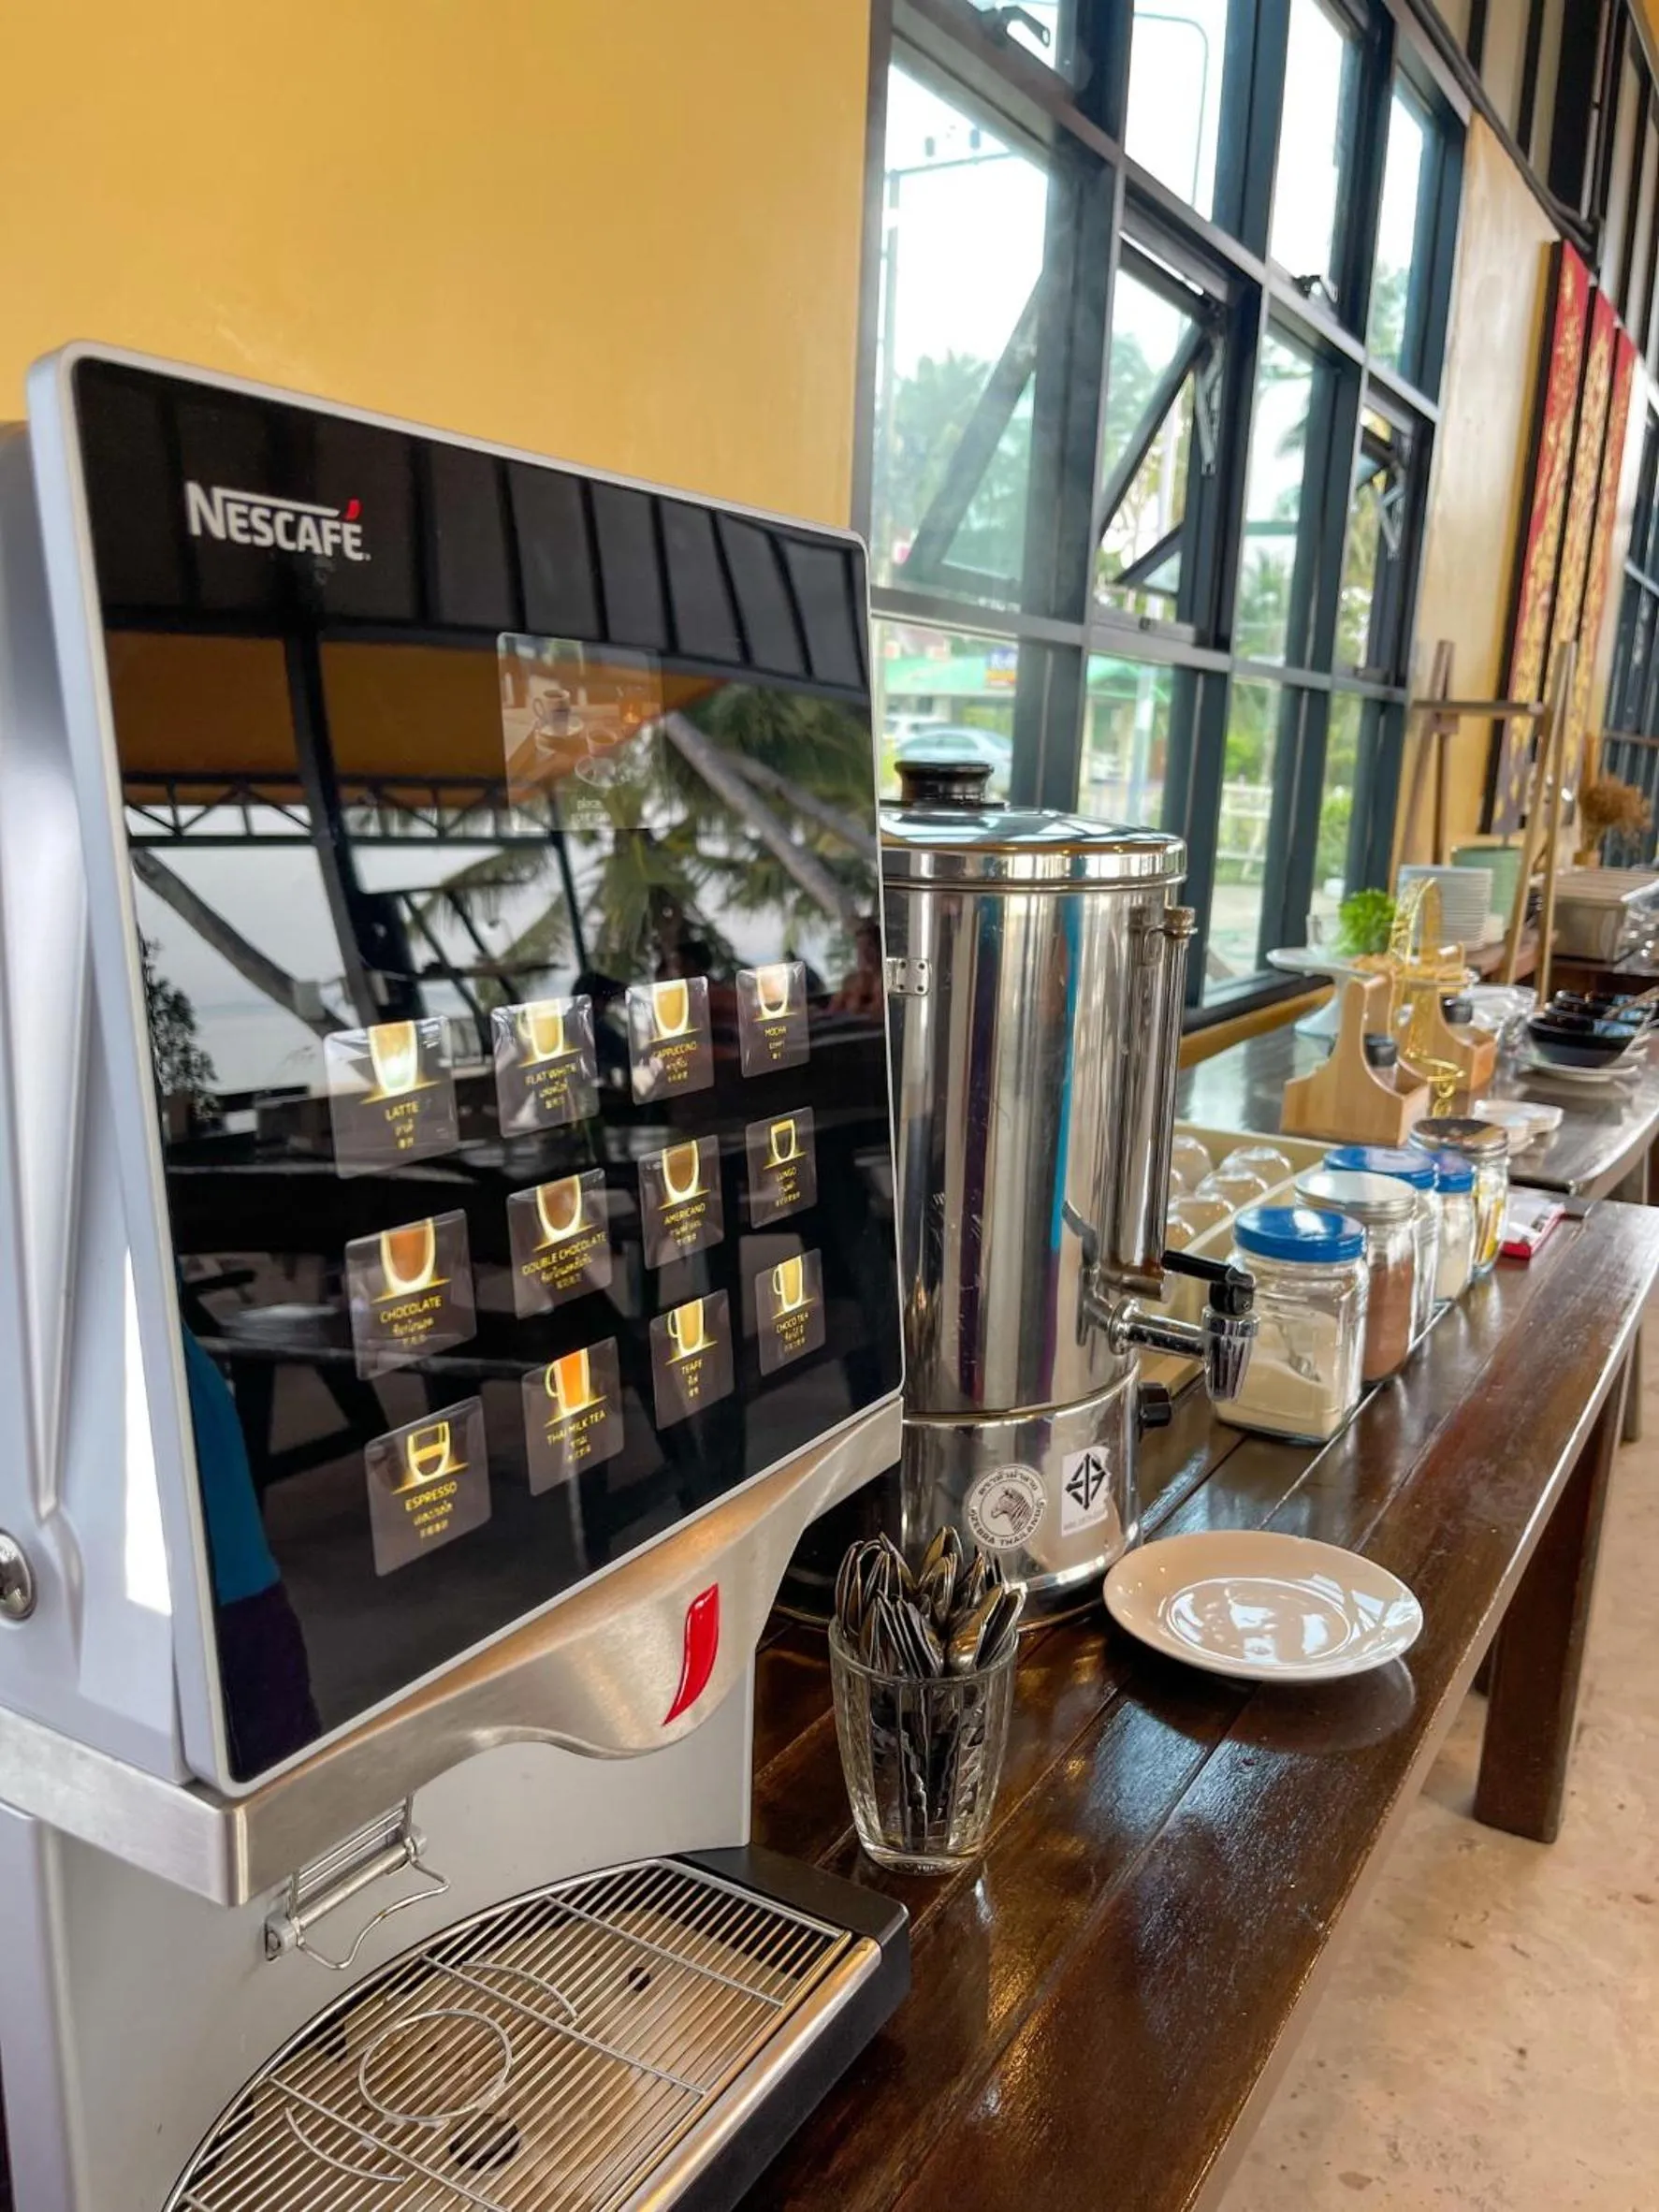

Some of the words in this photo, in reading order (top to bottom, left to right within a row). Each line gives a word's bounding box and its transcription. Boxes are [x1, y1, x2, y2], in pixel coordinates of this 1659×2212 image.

[385, 1100, 419, 1121] LATTE
[663, 1202, 706, 1225] AMERICANO
[521, 1252, 558, 1275] DOUBLE
[559, 1231, 607, 1260] CHOCOLATE
[380, 1295, 443, 1324] CHOCOLATE
[546, 1429, 567, 1446] THAI
[568, 1419, 588, 1434] MILK
[589, 1410, 606, 1423] TEA
[405, 1481, 458, 1512] ESPRESSO
[970, 1515, 996, 1544] ZEBRA
[1000, 1509, 1041, 1546] THAILAND
